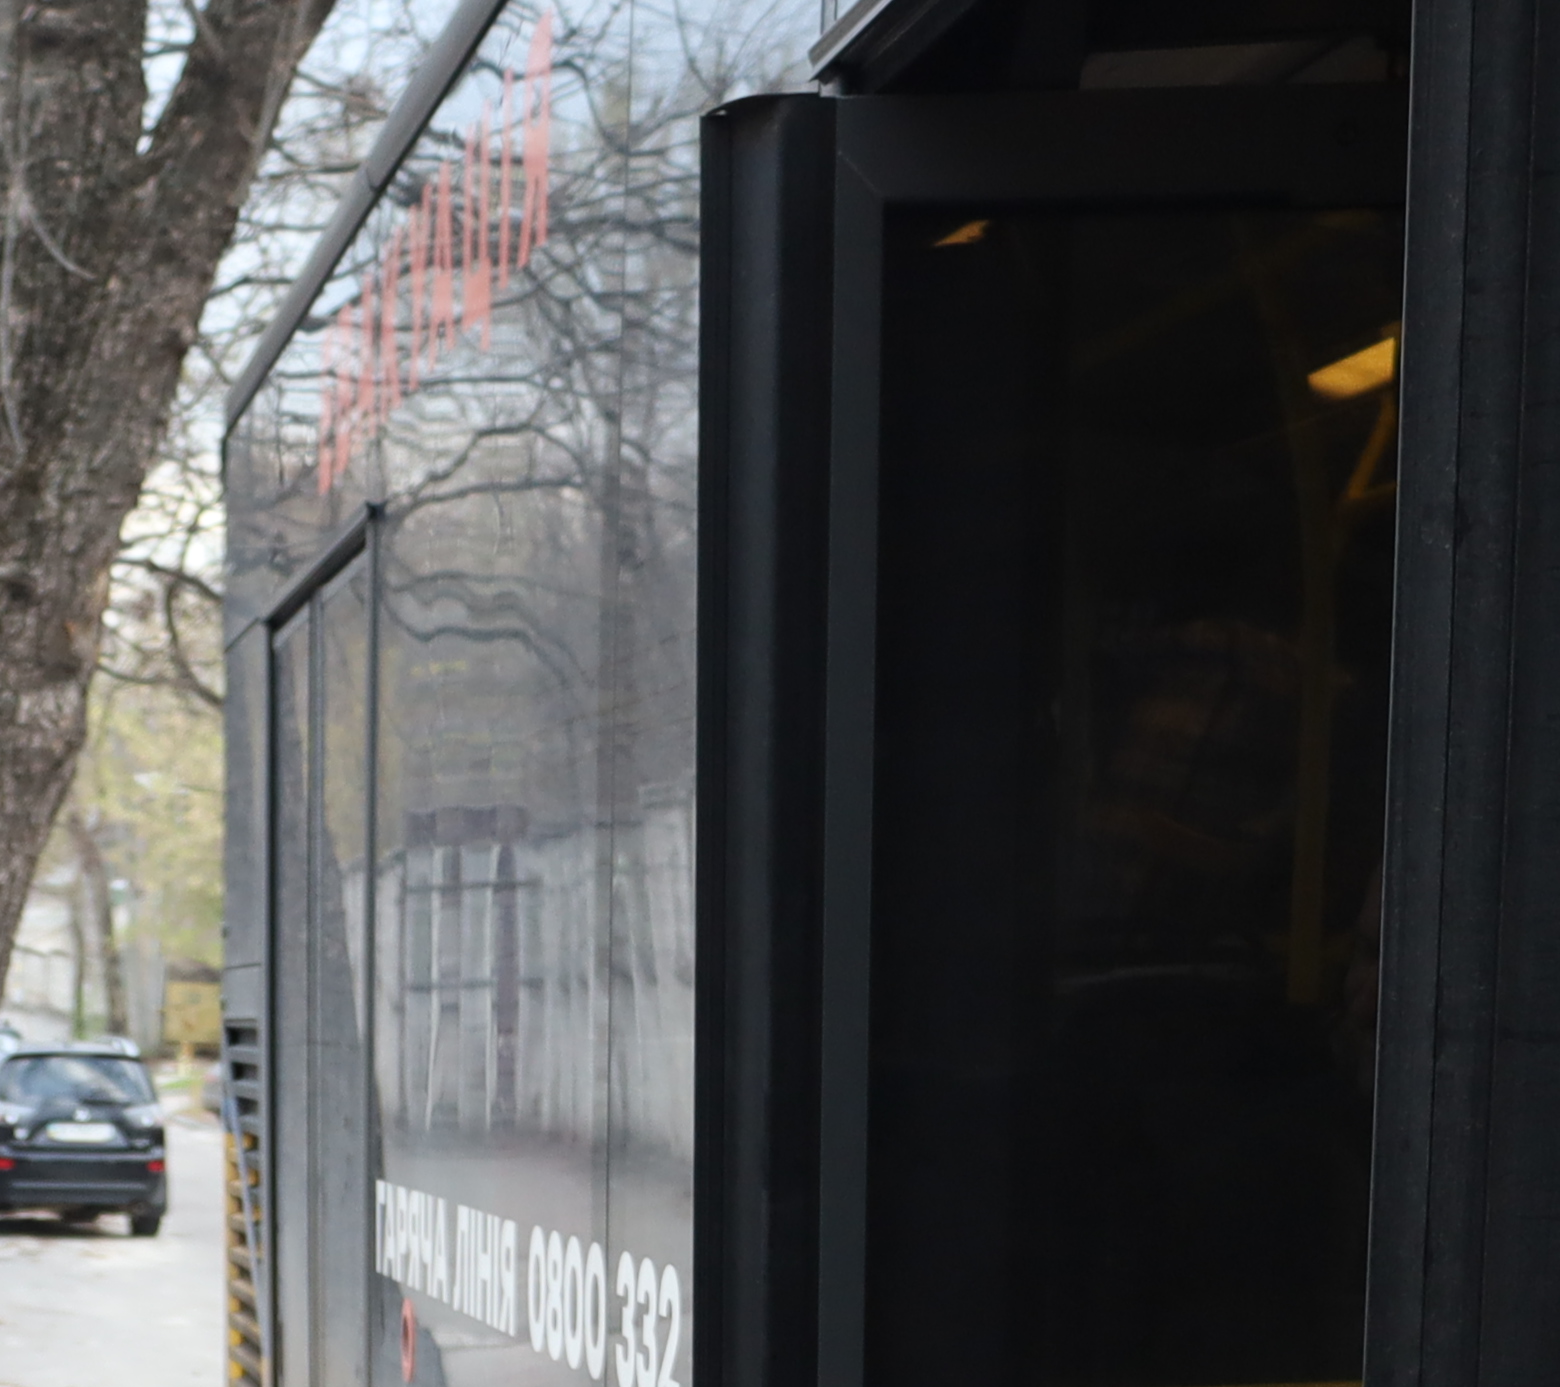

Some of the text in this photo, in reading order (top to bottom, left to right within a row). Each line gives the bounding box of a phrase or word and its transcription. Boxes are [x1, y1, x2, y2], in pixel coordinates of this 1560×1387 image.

[375, 1179, 450, 1304] ГАРЯЧА
[452, 1203, 517, 1338] ЛІНІЯ
[526, 1224, 607, 1381] 0800
